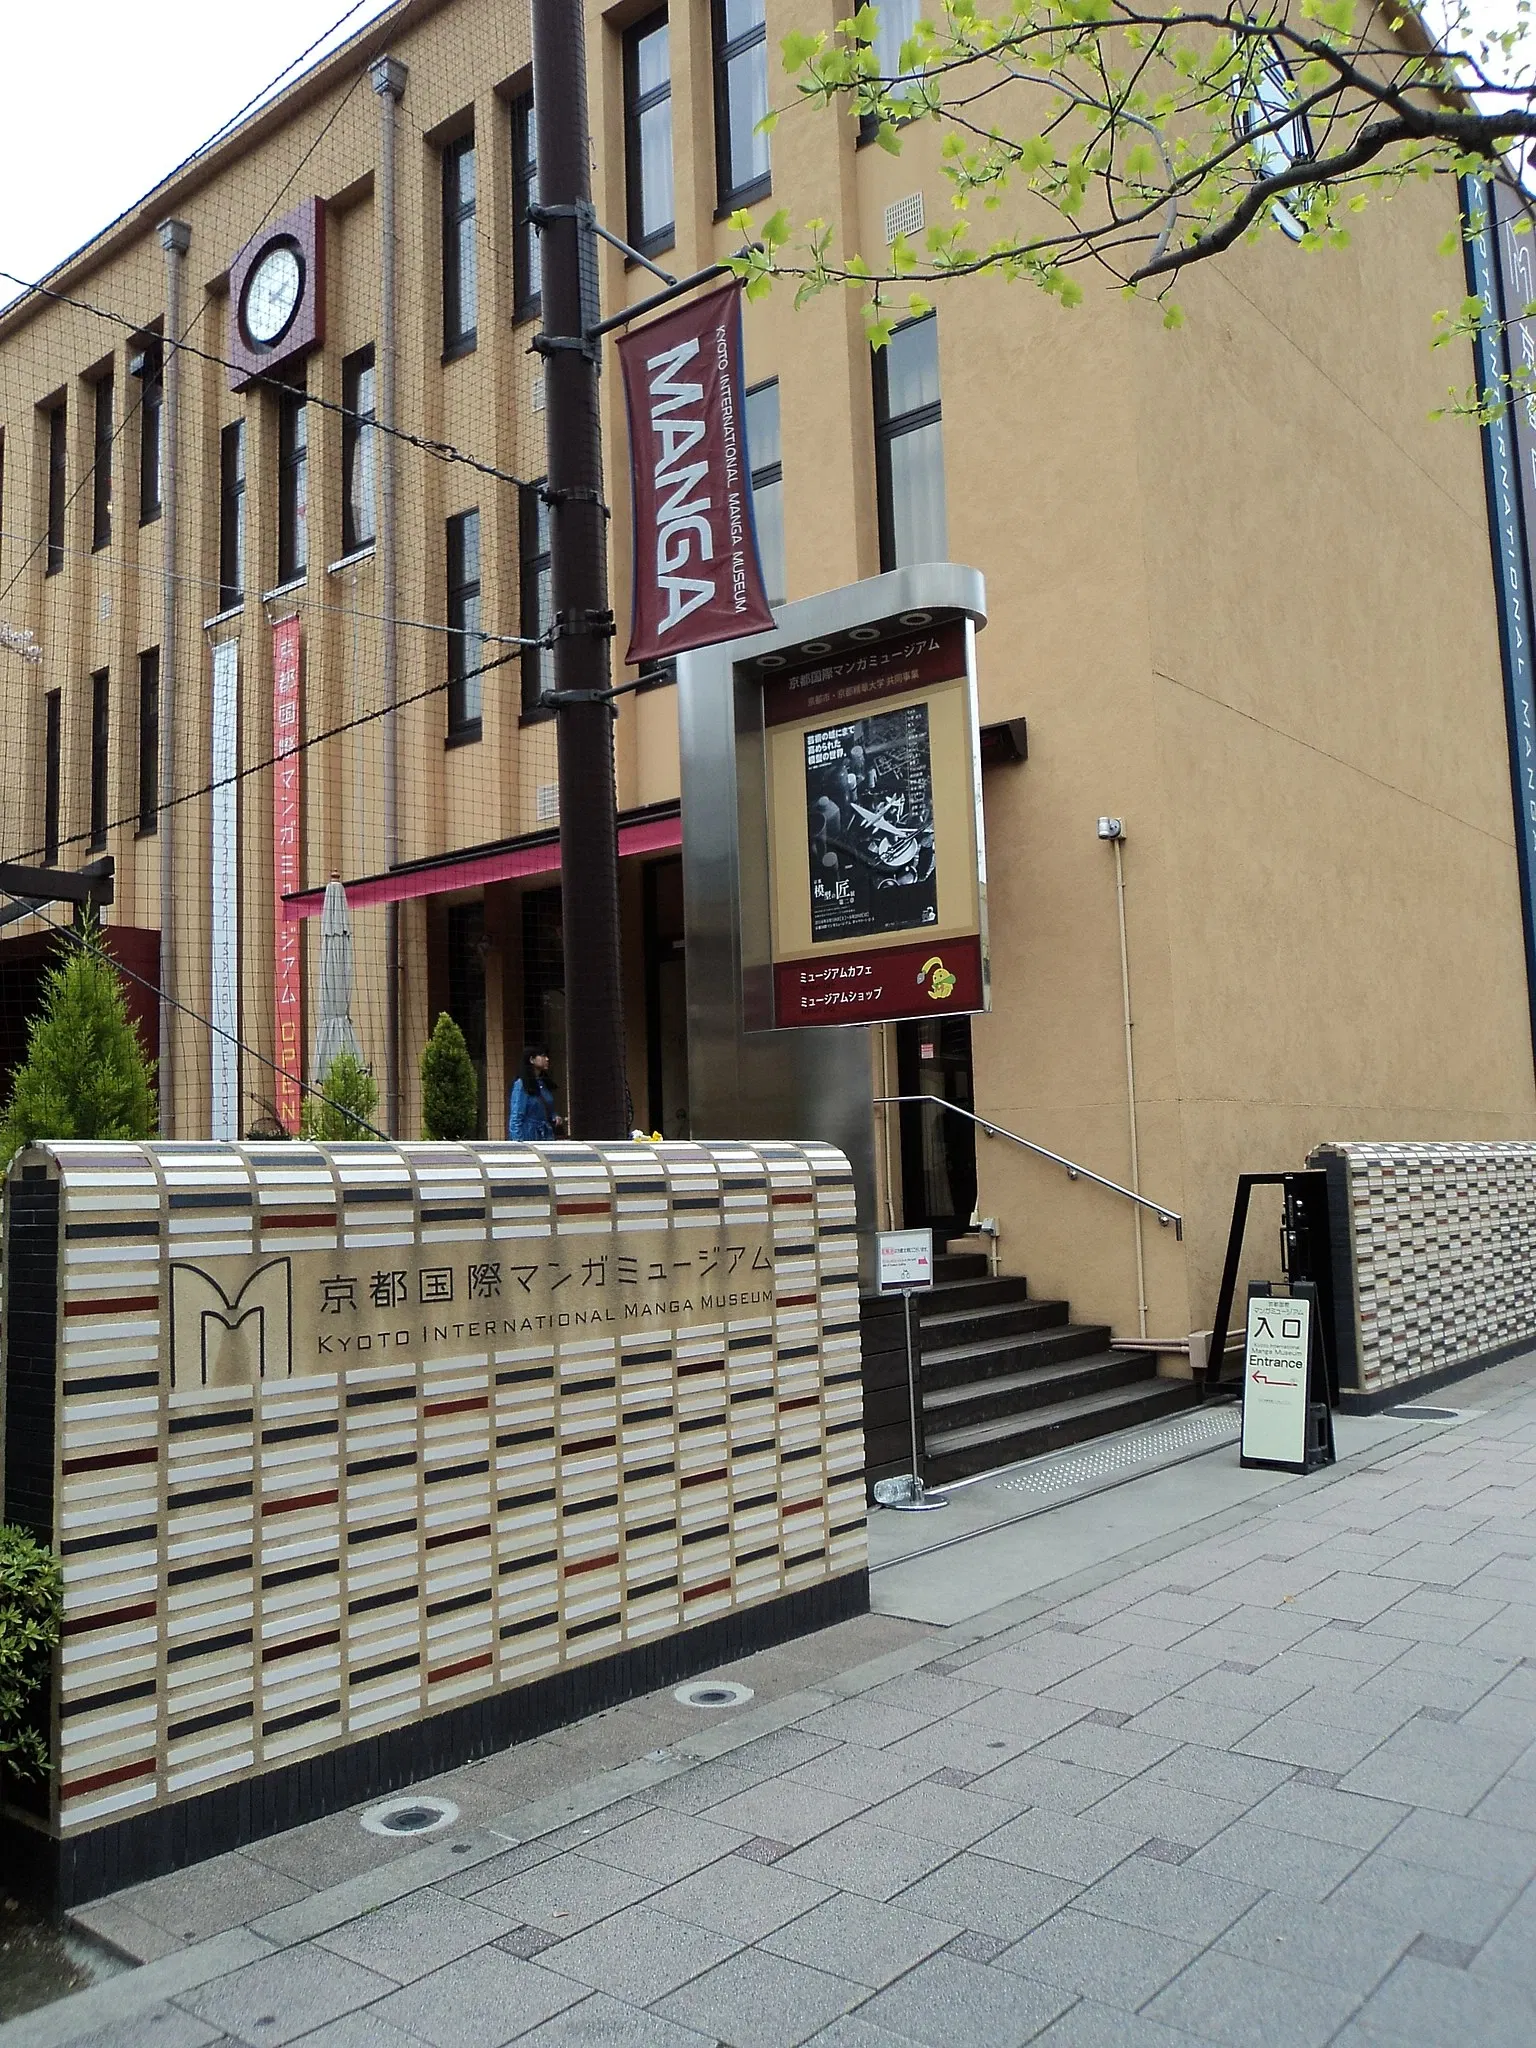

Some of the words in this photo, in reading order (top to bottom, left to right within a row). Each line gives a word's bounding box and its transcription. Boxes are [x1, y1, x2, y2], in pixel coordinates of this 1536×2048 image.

[715, 324, 729, 372] KYOTO
[719, 373, 737, 489] INTERNATIONAL
[646, 336, 717, 636] MANGA
[726, 490, 742, 546] MANGA
[731, 551, 748, 614] MUSEUM
[788, 637, 941, 691] 京都国際マンガミュージアム
[279, 638, 297, 1004] 京都国際マンガミュジアム
[800, 965, 873, 984] ミュージアムカフェ
[800, 986, 883, 1008] ミュージアムショップ
[280, 1021, 297, 1121] OPEN
[319, 1244, 773, 1315] 京都国際マンガミュージアム
[317, 1327, 411, 1355] KYOTO
[421, 1307, 617, 1344] INTERNATIONAL
[623, 1297, 694, 1320] MANGA
[699, 1288, 774, 1312] MUSEUM
[1254, 1317, 1302, 1339] 入口
[1249, 1354, 1303, 1369] Entrance
